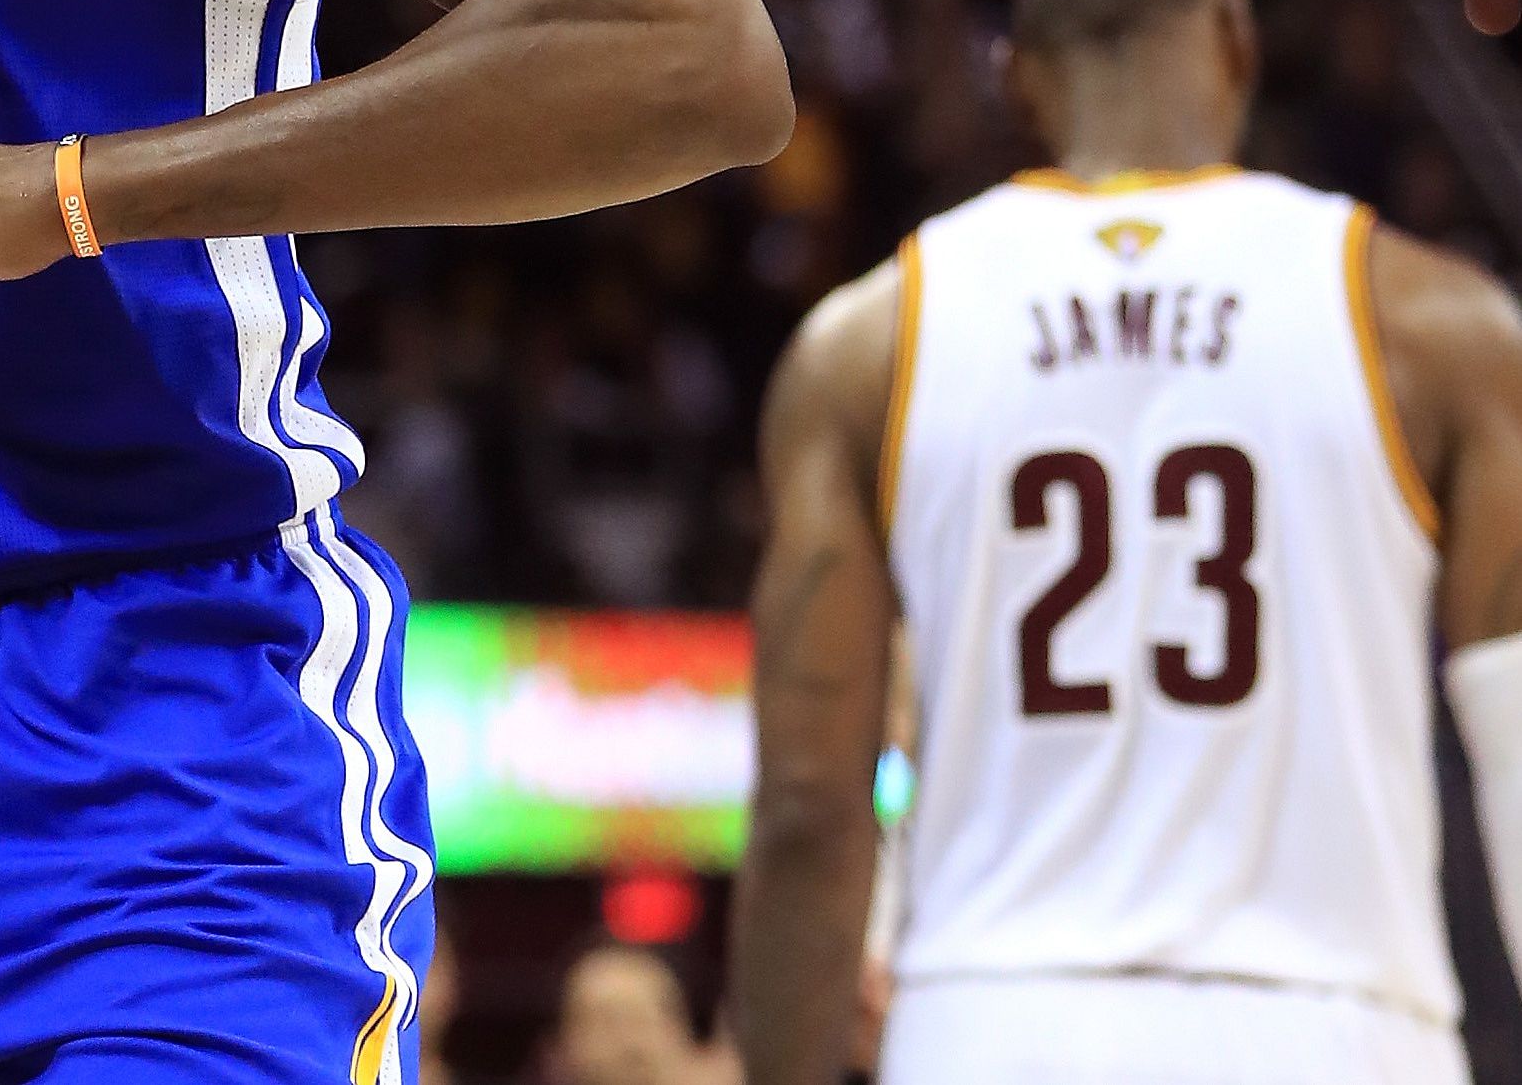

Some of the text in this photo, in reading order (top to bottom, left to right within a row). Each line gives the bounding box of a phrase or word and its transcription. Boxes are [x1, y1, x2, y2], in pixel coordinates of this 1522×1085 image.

[64, 195, 94, 256] STRONG
[1028, 286, 1241, 372] JAMES
[1011, 442, 1260, 715] 23
